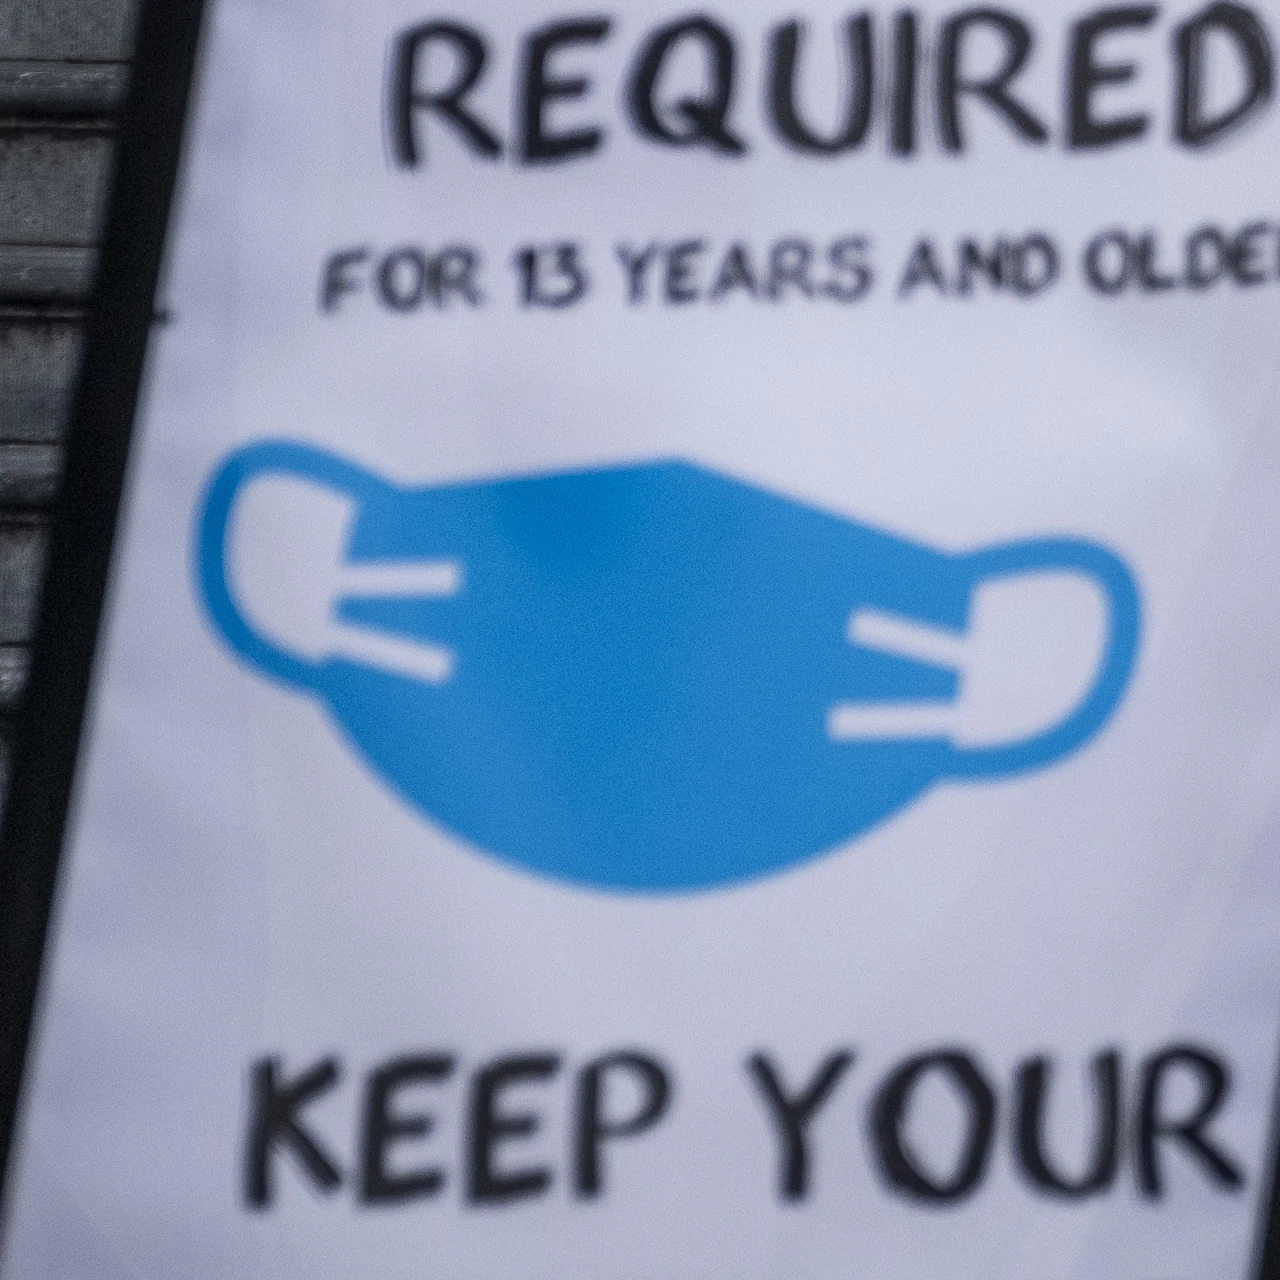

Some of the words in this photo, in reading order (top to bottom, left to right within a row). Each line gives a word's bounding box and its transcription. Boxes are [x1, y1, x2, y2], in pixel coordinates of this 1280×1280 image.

[317, 244, 484, 315] FOR
[511, 241, 590, 310] 13
[614, 235, 876, 308] YEARS
[898, 231, 1063, 299] AND
[240, 1049, 674, 1213] KEEP
[746, 1042, 1247, 1208] YOUR
